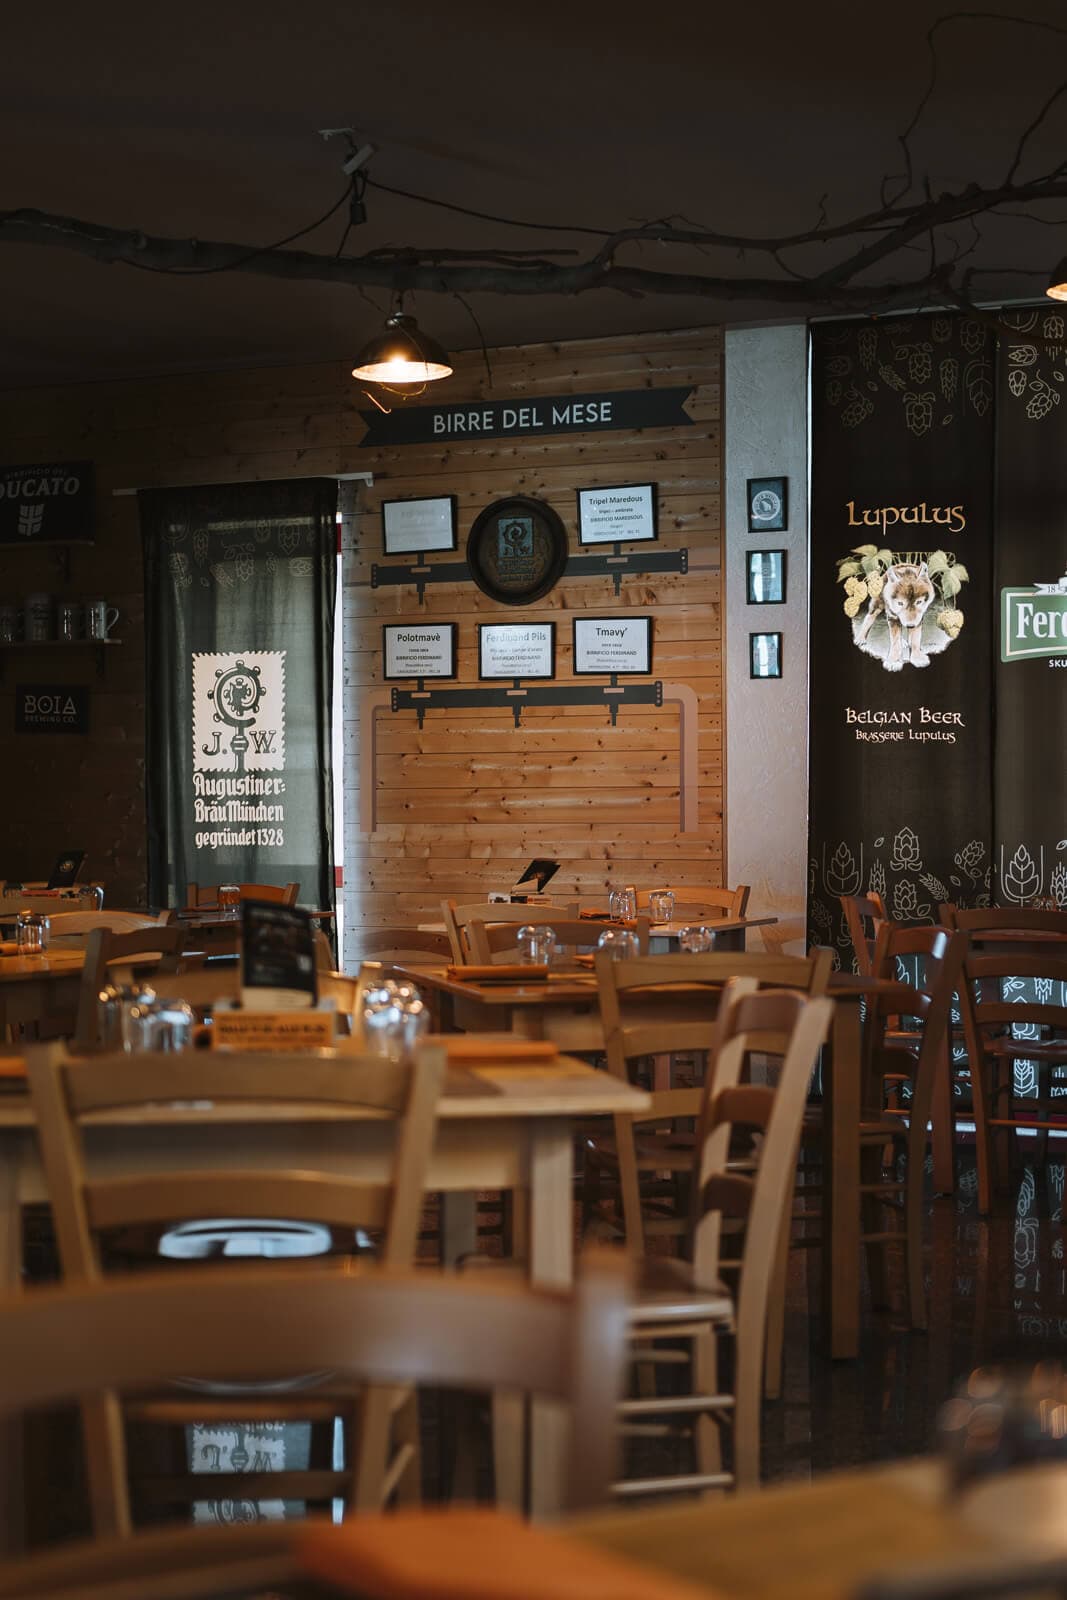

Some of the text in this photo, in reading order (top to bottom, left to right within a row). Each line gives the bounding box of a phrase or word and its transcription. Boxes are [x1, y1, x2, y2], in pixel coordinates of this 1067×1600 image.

[433, 402, 613, 434] BIRRE DEL MESE
[588, 497, 608, 506] Tripel
[846, 501, 966, 535] Lupulus
[531, 631, 547, 641] Pils
[24, 695, 77, 714] BOIA
[194, 798, 284, 822] Bräu München
[195, 828, 284, 849] gegründet 1328
